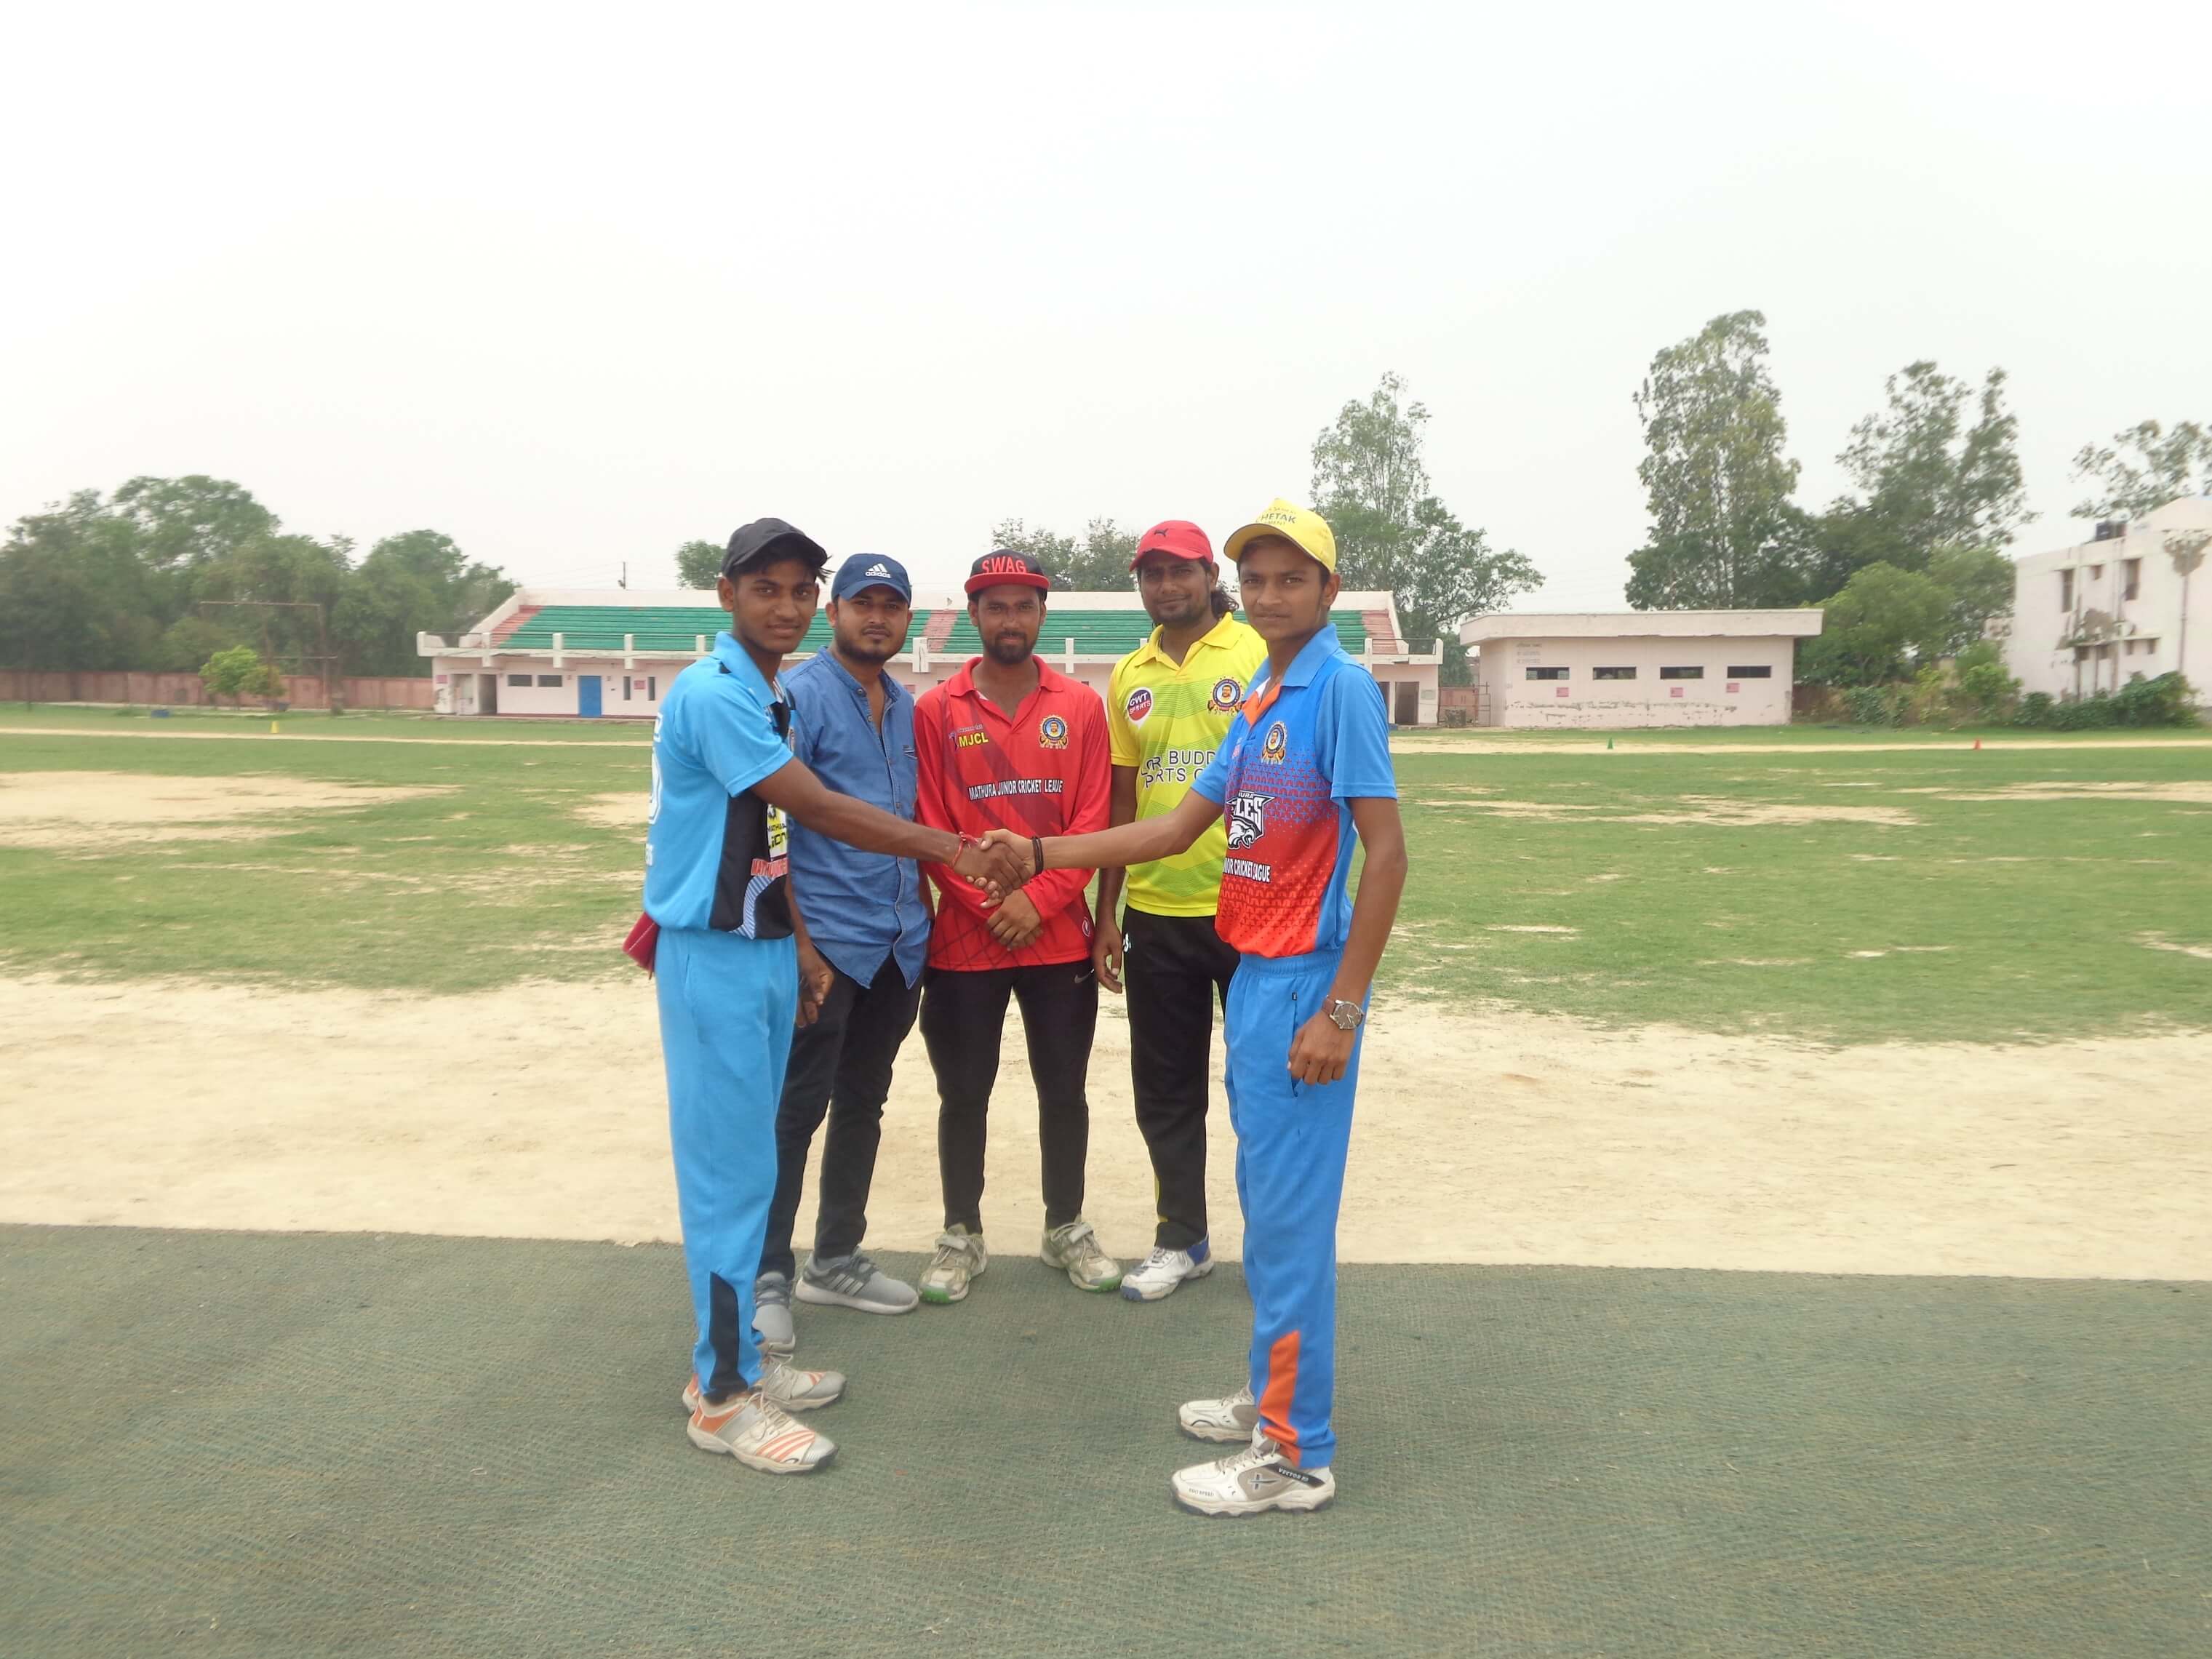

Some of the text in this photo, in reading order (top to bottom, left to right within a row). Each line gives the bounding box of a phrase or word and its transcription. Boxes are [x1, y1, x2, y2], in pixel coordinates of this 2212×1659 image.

[982, 556, 1027, 573] SWAG
[865, 571, 891, 579] adidas
[1129, 692, 1148, 706] CWT
[959, 732, 989, 748] MJCL
[968, 783, 997, 801] MATHURA
[1018, 779, 1042, 794] CRICKET
